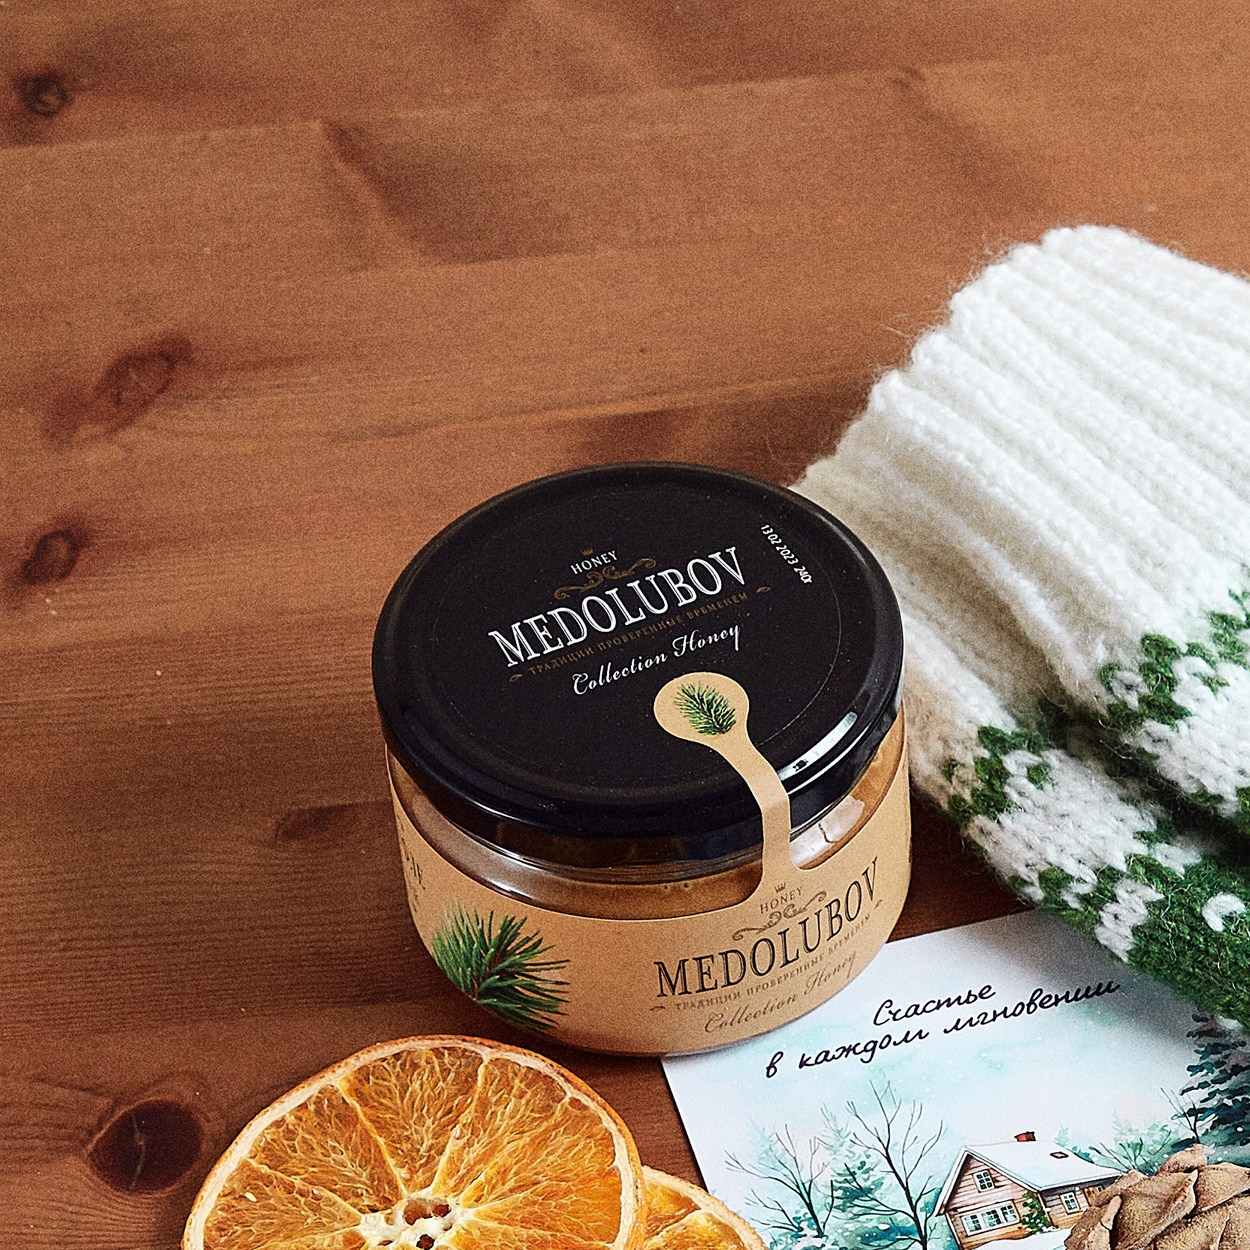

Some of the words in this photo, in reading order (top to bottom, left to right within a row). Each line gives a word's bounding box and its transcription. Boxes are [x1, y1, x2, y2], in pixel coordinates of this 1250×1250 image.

[570, 550, 618, 575] HONEY
[775, 544, 799, 565] 2023
[488, 546, 746, 668] MEDOLUBOV
[528, 646, 595, 676] ТРАДИЦИИ
[596, 614, 683, 651] ПРОВЕРЕННЫЕ
[686, 591, 749, 621] ВРЕМЕНЕМ
[571, 653, 668, 696] Collection
[672, 624, 741, 652] Honey
[654, 856, 878, 998] MEDOLUBOV
[759, 886, 805, 915] HONEY
[674, 991, 742, 1012] ТРАДИЦИИ
[746, 954, 825, 997] ПРОВЕРЕННЫЕ
[704, 992, 798, 1033] Collection
[803, 950, 857, 995] Honey
[873, 984, 997, 1026] Счастье
[765, 1051, 784, 1079] в
[797, 1029, 930, 1069] каждом
[943, 980, 1121, 1034] мгновении
